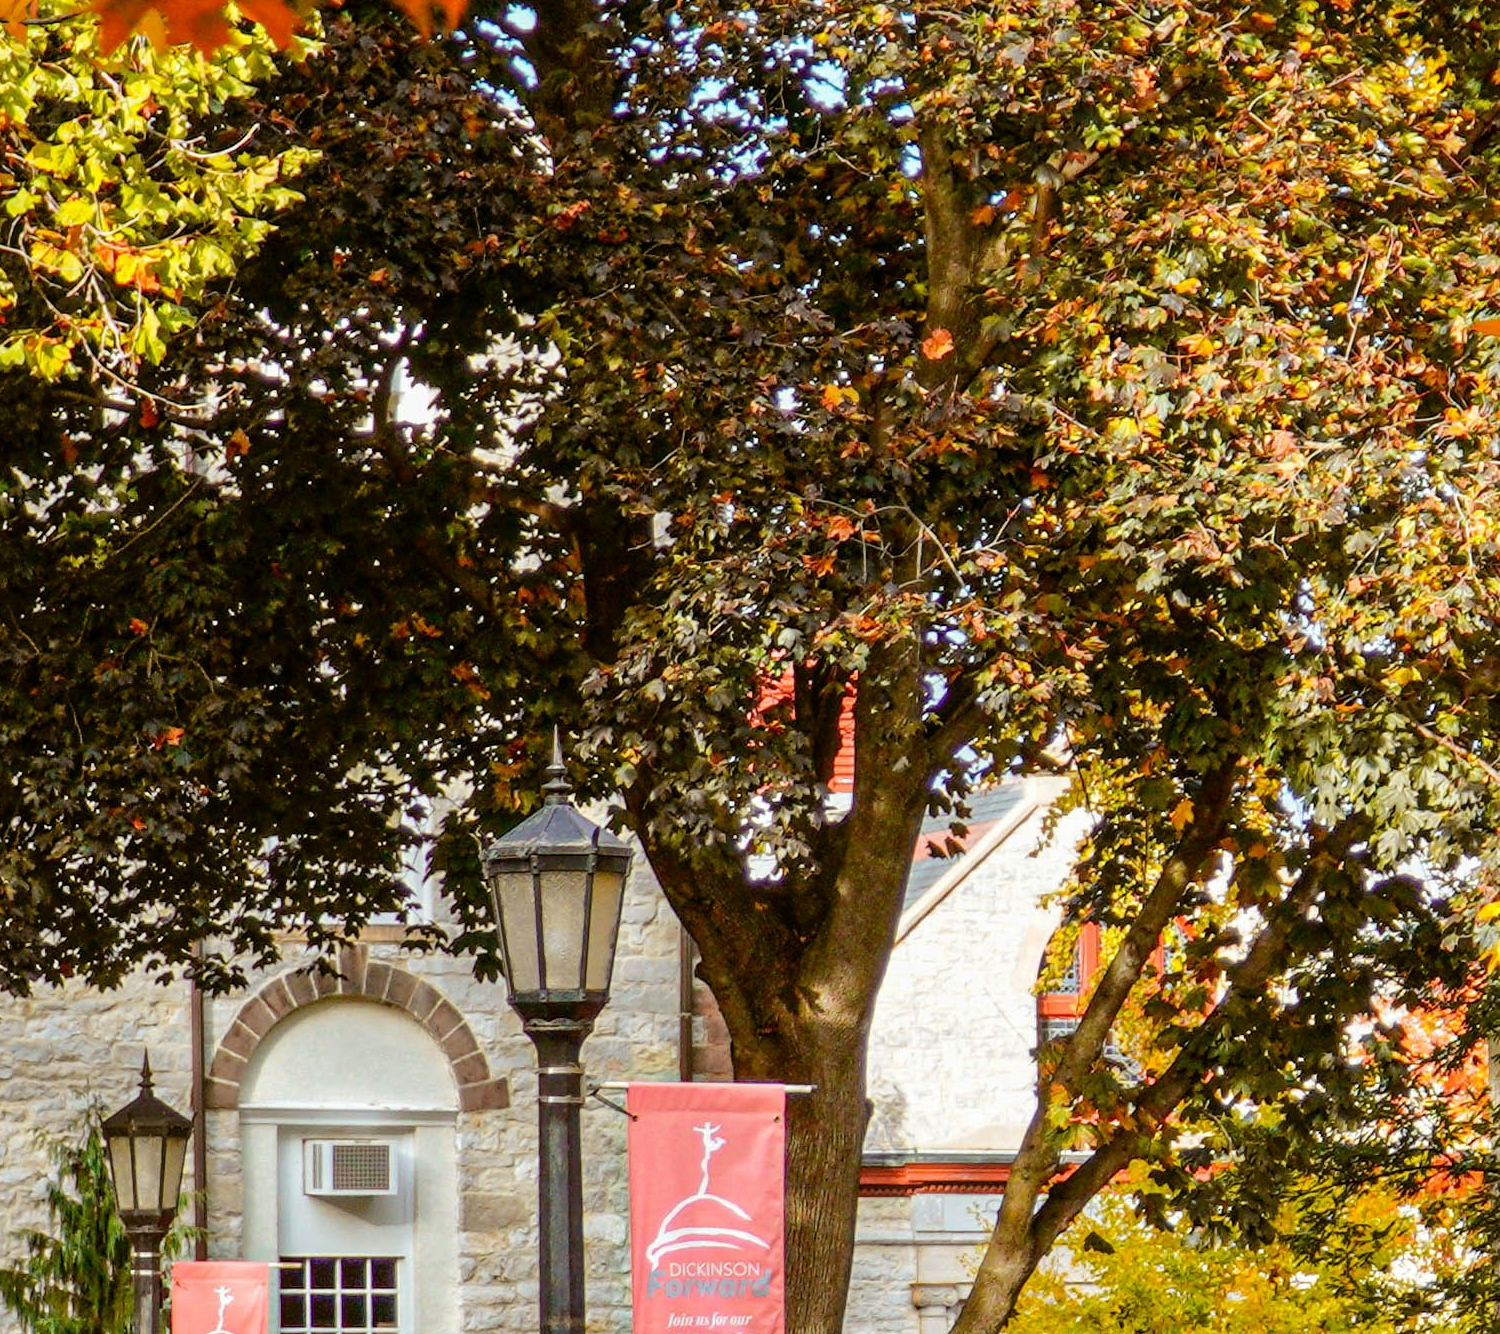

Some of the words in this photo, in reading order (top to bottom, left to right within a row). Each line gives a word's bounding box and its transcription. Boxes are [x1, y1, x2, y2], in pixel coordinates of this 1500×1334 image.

[669, 1262, 760, 1277] DICKINSON
[646, 1268, 772, 1299] Forward
[667, 1313, 692, 1328] Join
[696, 1316, 709, 1326] us
[709, 1312, 729, 1329] for
[730, 1315, 752, 1326] our
